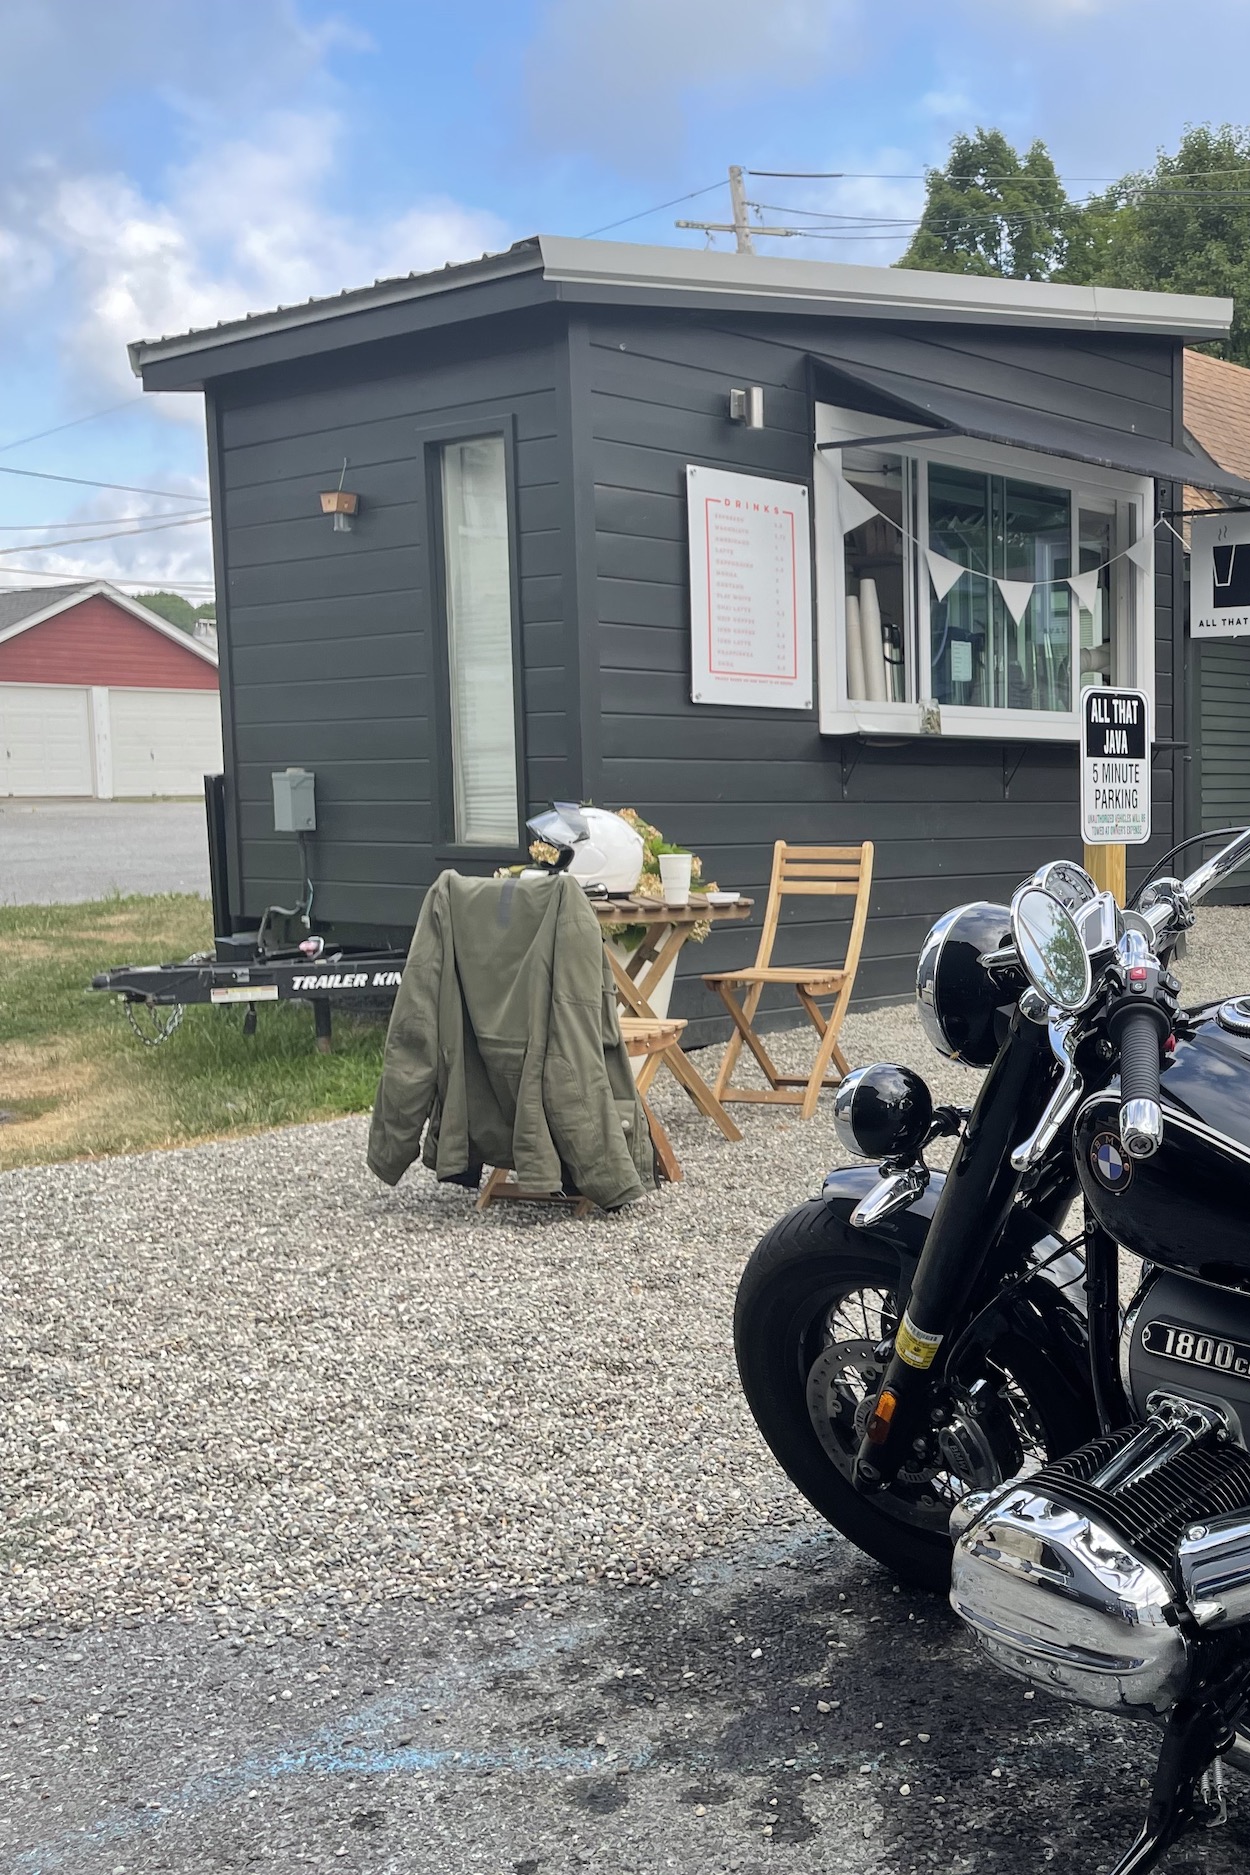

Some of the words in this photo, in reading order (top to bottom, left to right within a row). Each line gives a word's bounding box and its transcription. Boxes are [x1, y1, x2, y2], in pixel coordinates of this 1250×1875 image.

[724, 498, 779, 515] DRINKS
[1199, 619, 1217, 628] ALL
[1221, 617, 1249, 627] THAT
[1091, 698, 1110, 724] ALL
[1112, 699, 1138, 725] THAT
[1103, 729, 1128, 755] JAVA
[1092, 763, 1099, 783] 5
[1102, 763, 1140, 783] MINUTE
[1095, 789, 1138, 810] PARKING
[292, 973, 368, 990] TRAILER
[949, 1445, 968, 1470] BMW
